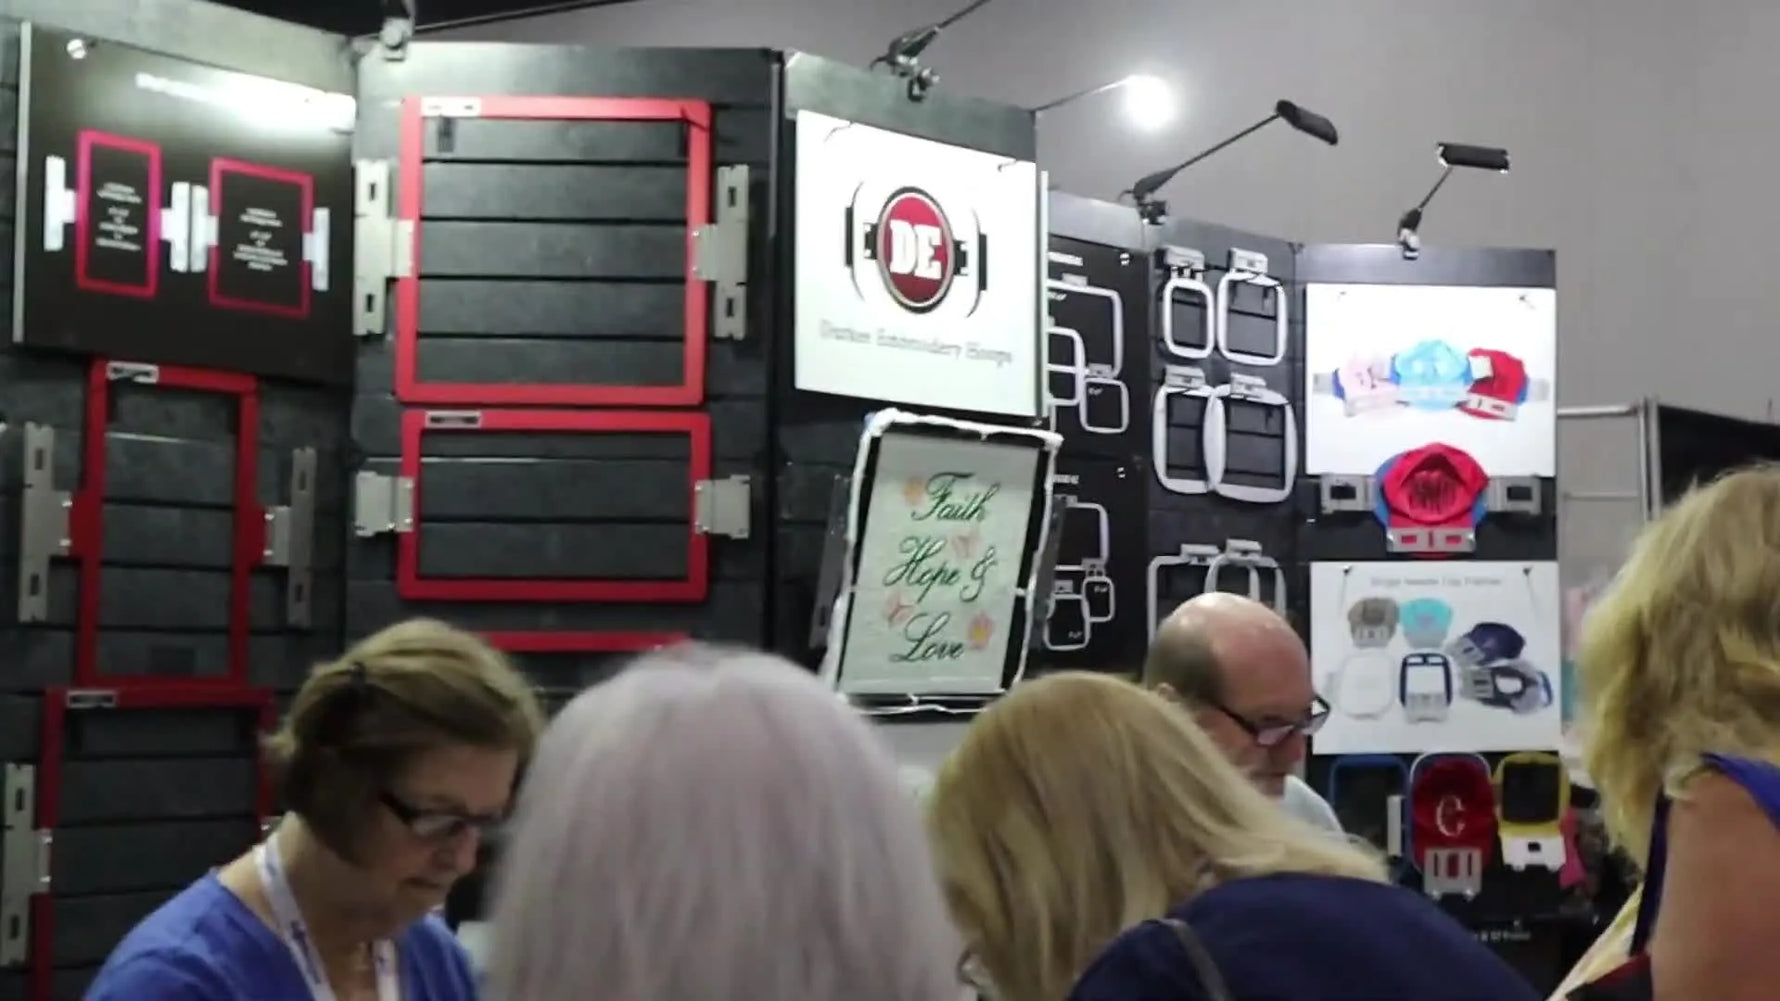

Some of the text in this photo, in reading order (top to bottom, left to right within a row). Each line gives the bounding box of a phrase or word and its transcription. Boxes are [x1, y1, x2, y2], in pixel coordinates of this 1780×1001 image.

[889, 218, 943, 280] DE
[911, 471, 1000, 522] Faith
[882, 536, 998, 603] Hope &
[889, 611, 965, 663] Love
